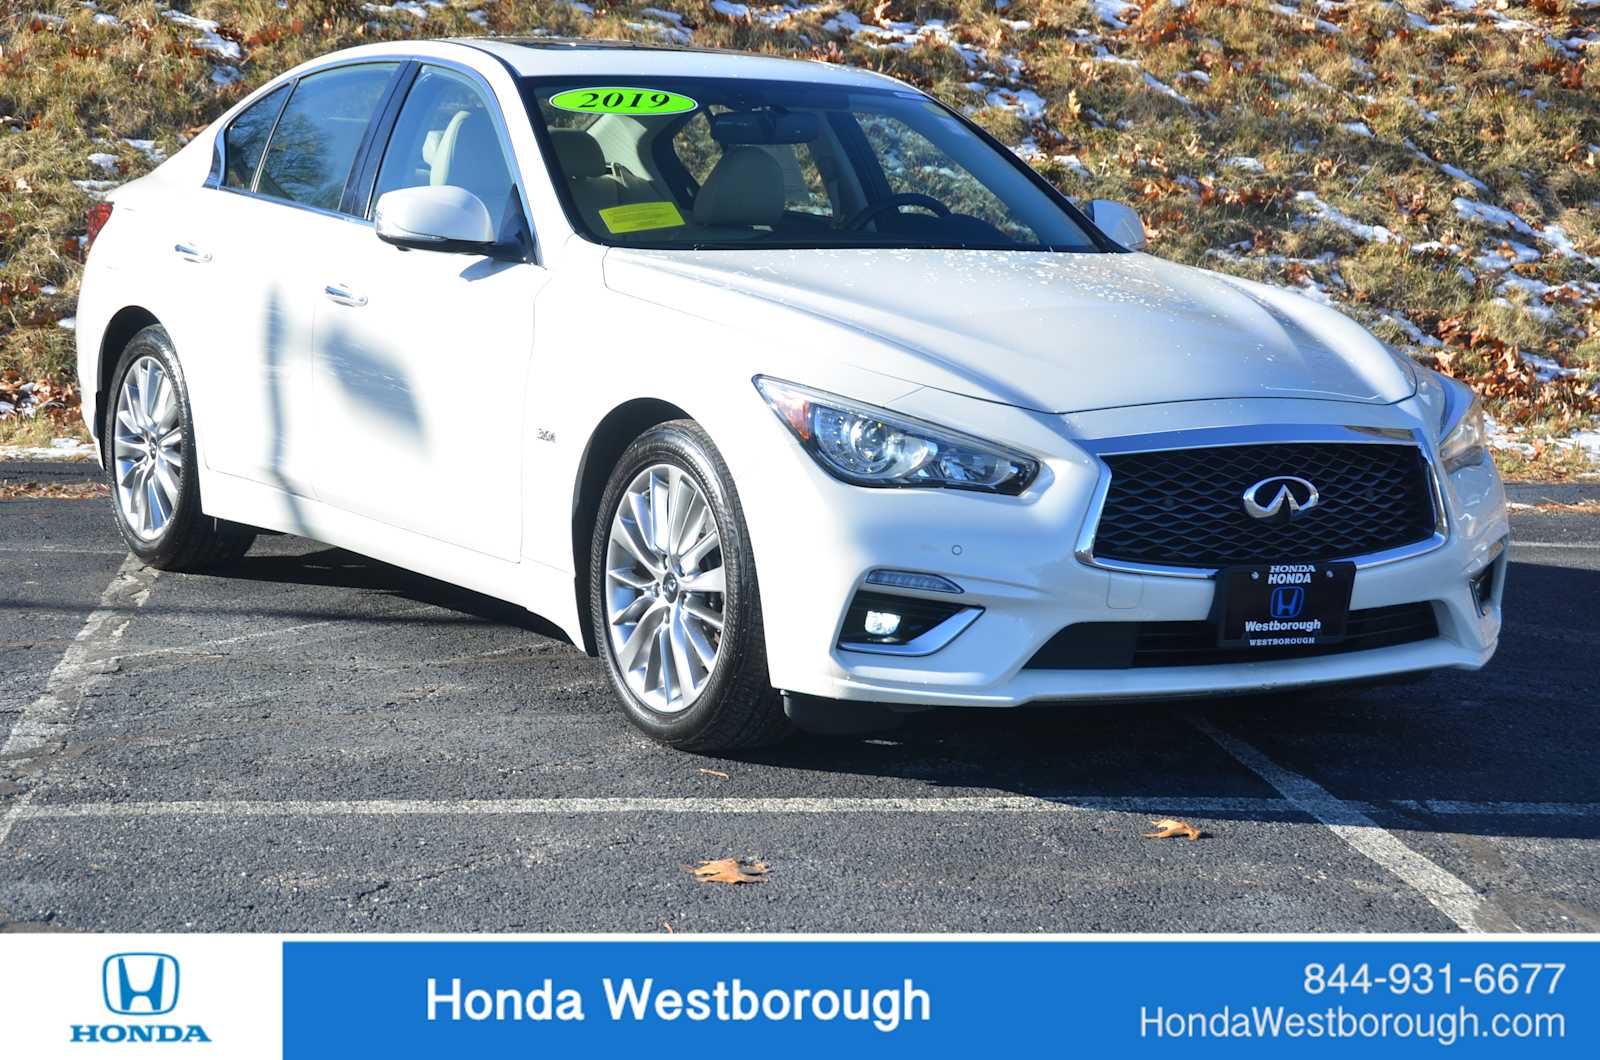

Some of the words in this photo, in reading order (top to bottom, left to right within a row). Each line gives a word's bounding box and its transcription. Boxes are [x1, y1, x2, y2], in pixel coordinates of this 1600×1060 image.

[578, 92, 670, 108] 2019
[1269, 565, 1316, 573] HONDA
[1268, 573, 1312, 584] HONDA
[1245, 619, 1321, 632] Westborough
[1249, 637, 1315, 646] WESTBOROUGH
